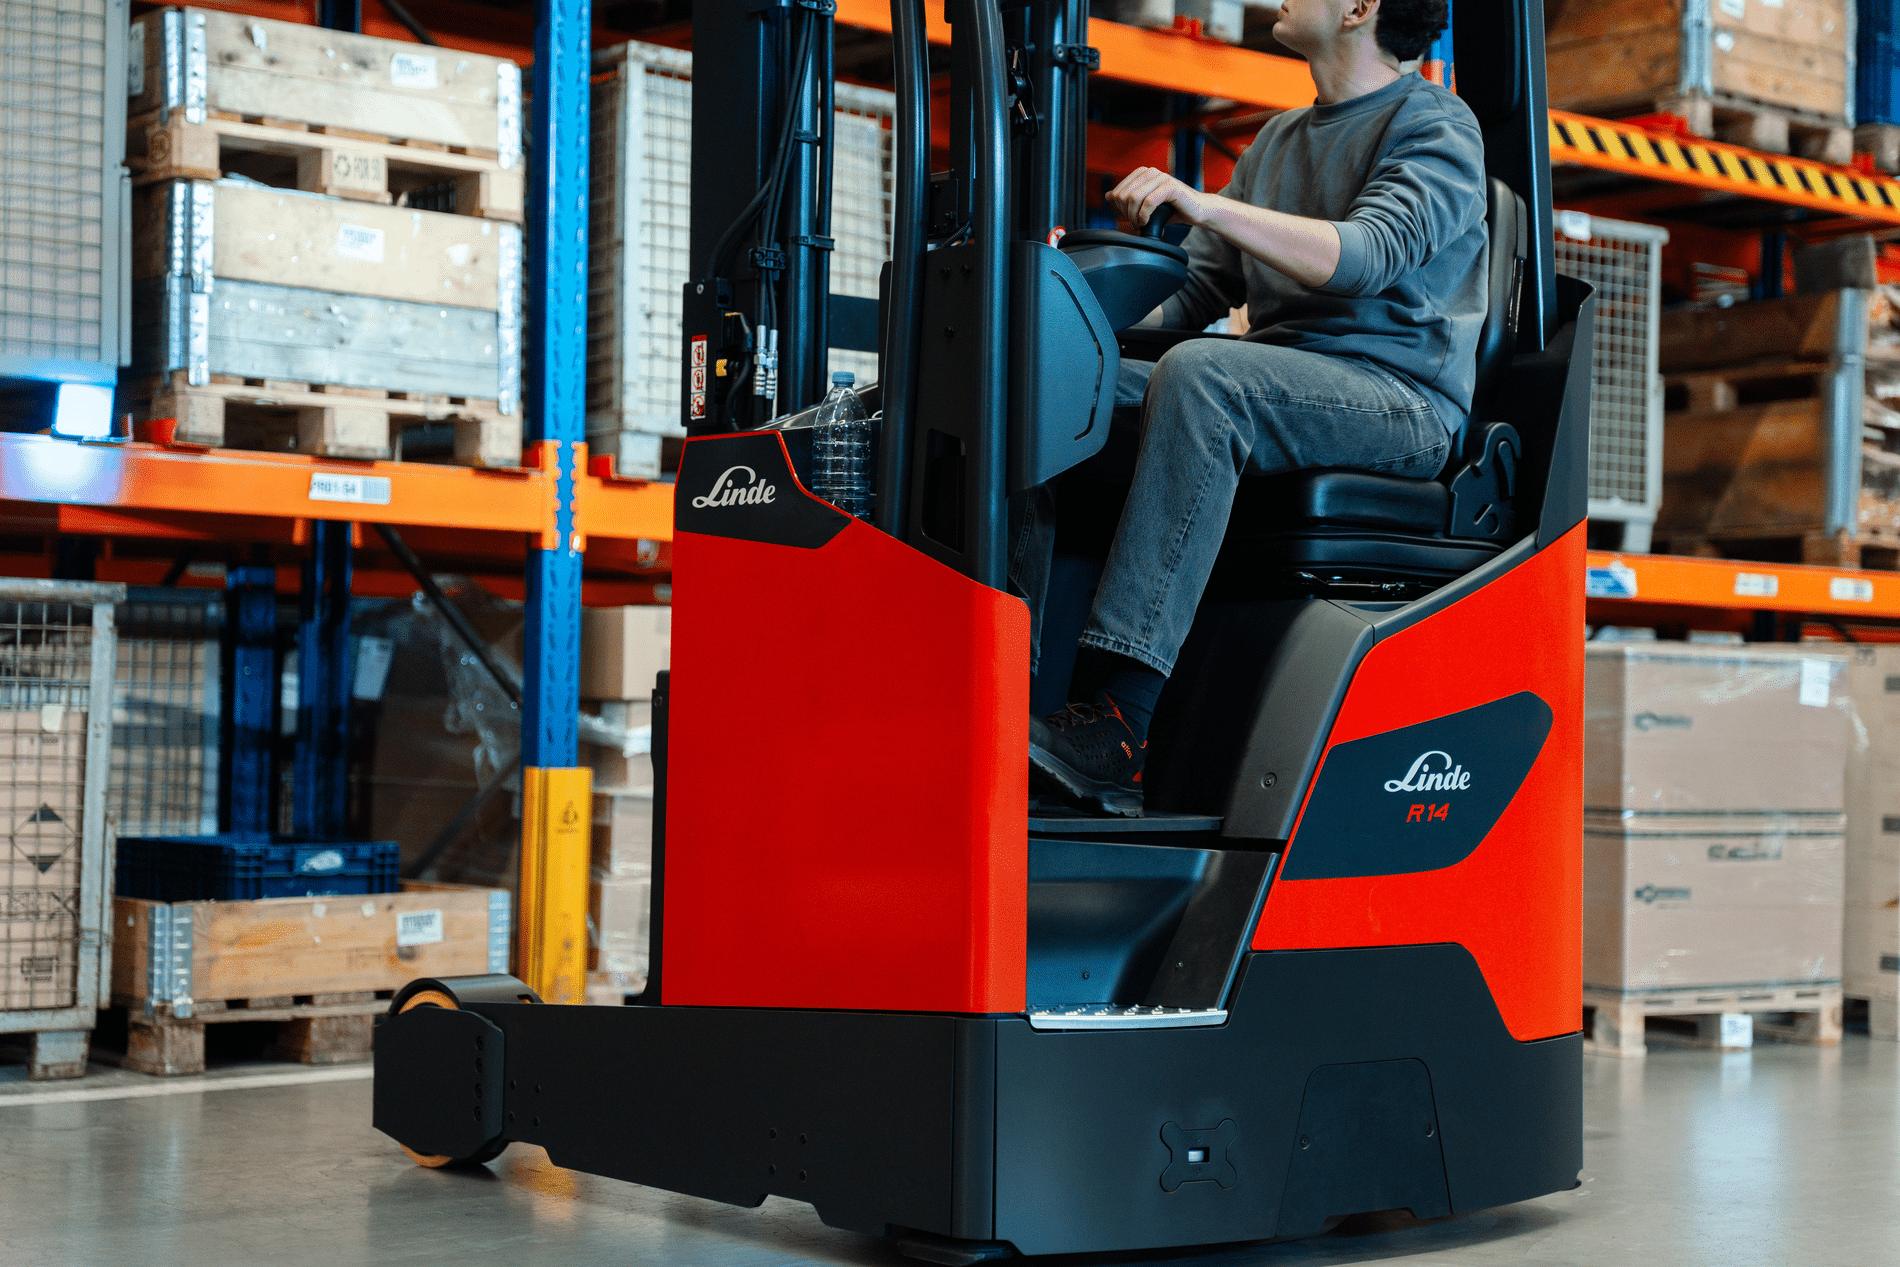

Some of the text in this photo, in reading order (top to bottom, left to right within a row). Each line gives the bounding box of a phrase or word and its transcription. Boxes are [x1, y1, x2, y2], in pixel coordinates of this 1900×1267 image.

[692, 465, 776, 509] Linde
[1384, 750, 1471, 792] Linde
[1406, 803, 1450, 823] R14
